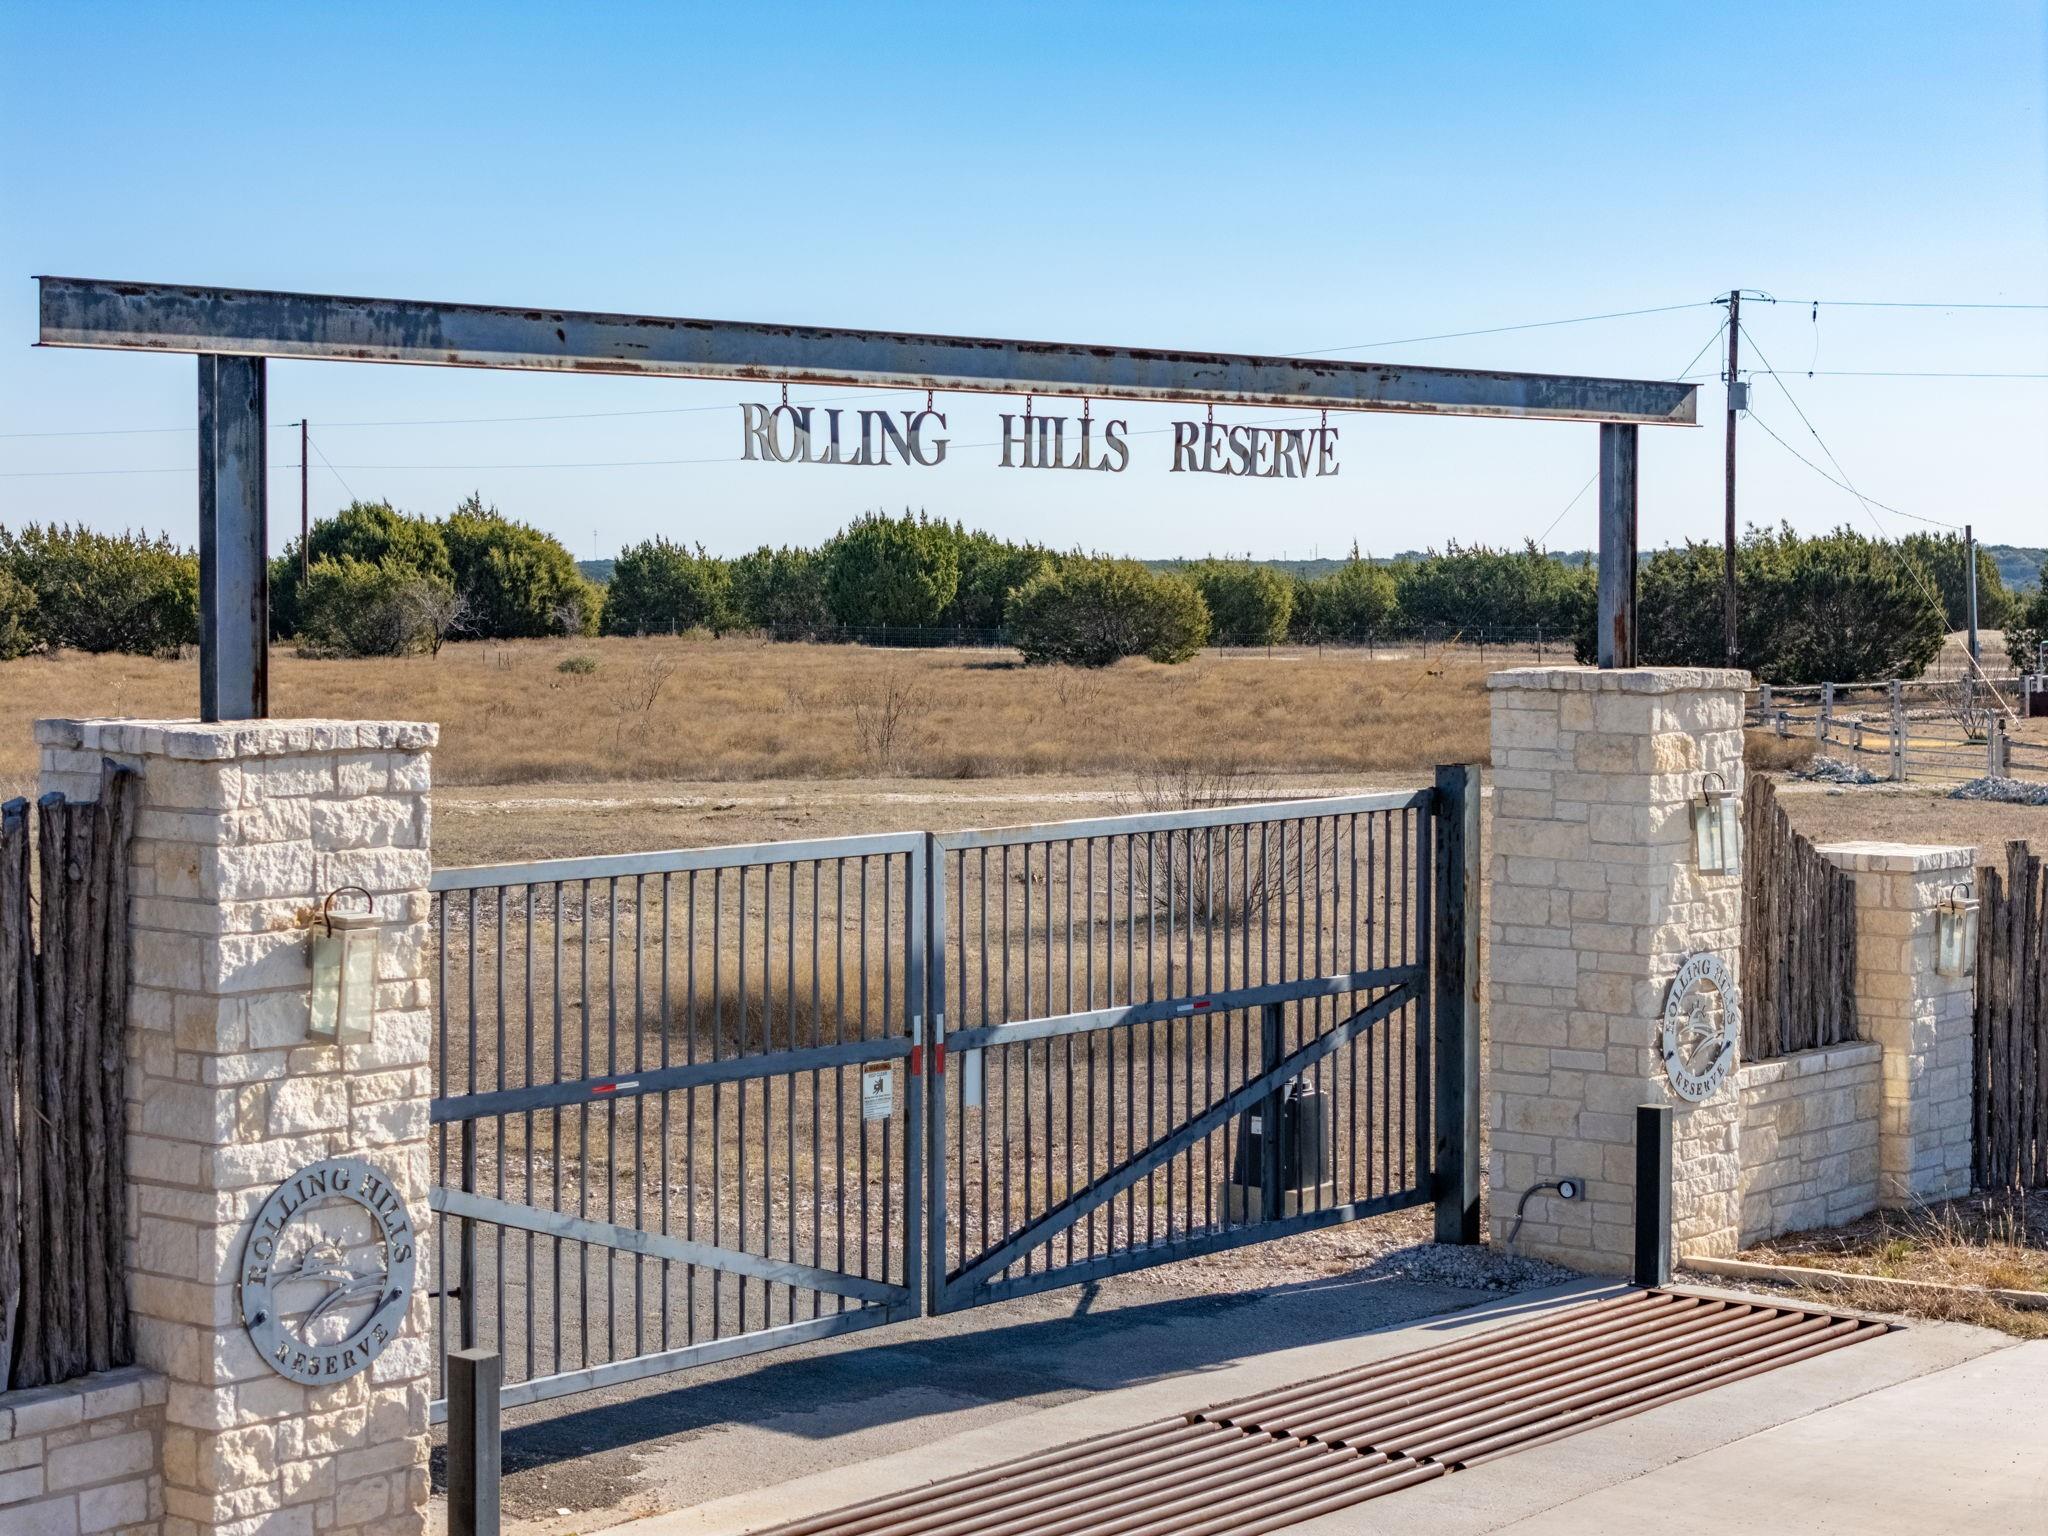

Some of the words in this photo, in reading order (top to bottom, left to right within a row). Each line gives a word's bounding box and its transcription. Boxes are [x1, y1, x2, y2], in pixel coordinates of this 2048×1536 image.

[739, 402, 951, 467] ROLLING
[999, 413, 1129, 473] HILLS
[1170, 421, 1340, 478] RESERVE
[1666, 959, 1711, 1034] ROLLING
[1714, 963, 1736, 1025] HILLS
[1675, 1063, 1725, 1096] RESERVE
[248, 1169, 350, 1287] ROLLING
[359, 1174, 412, 1264] HILLS
[274, 1323, 389, 1376] RESERVE
